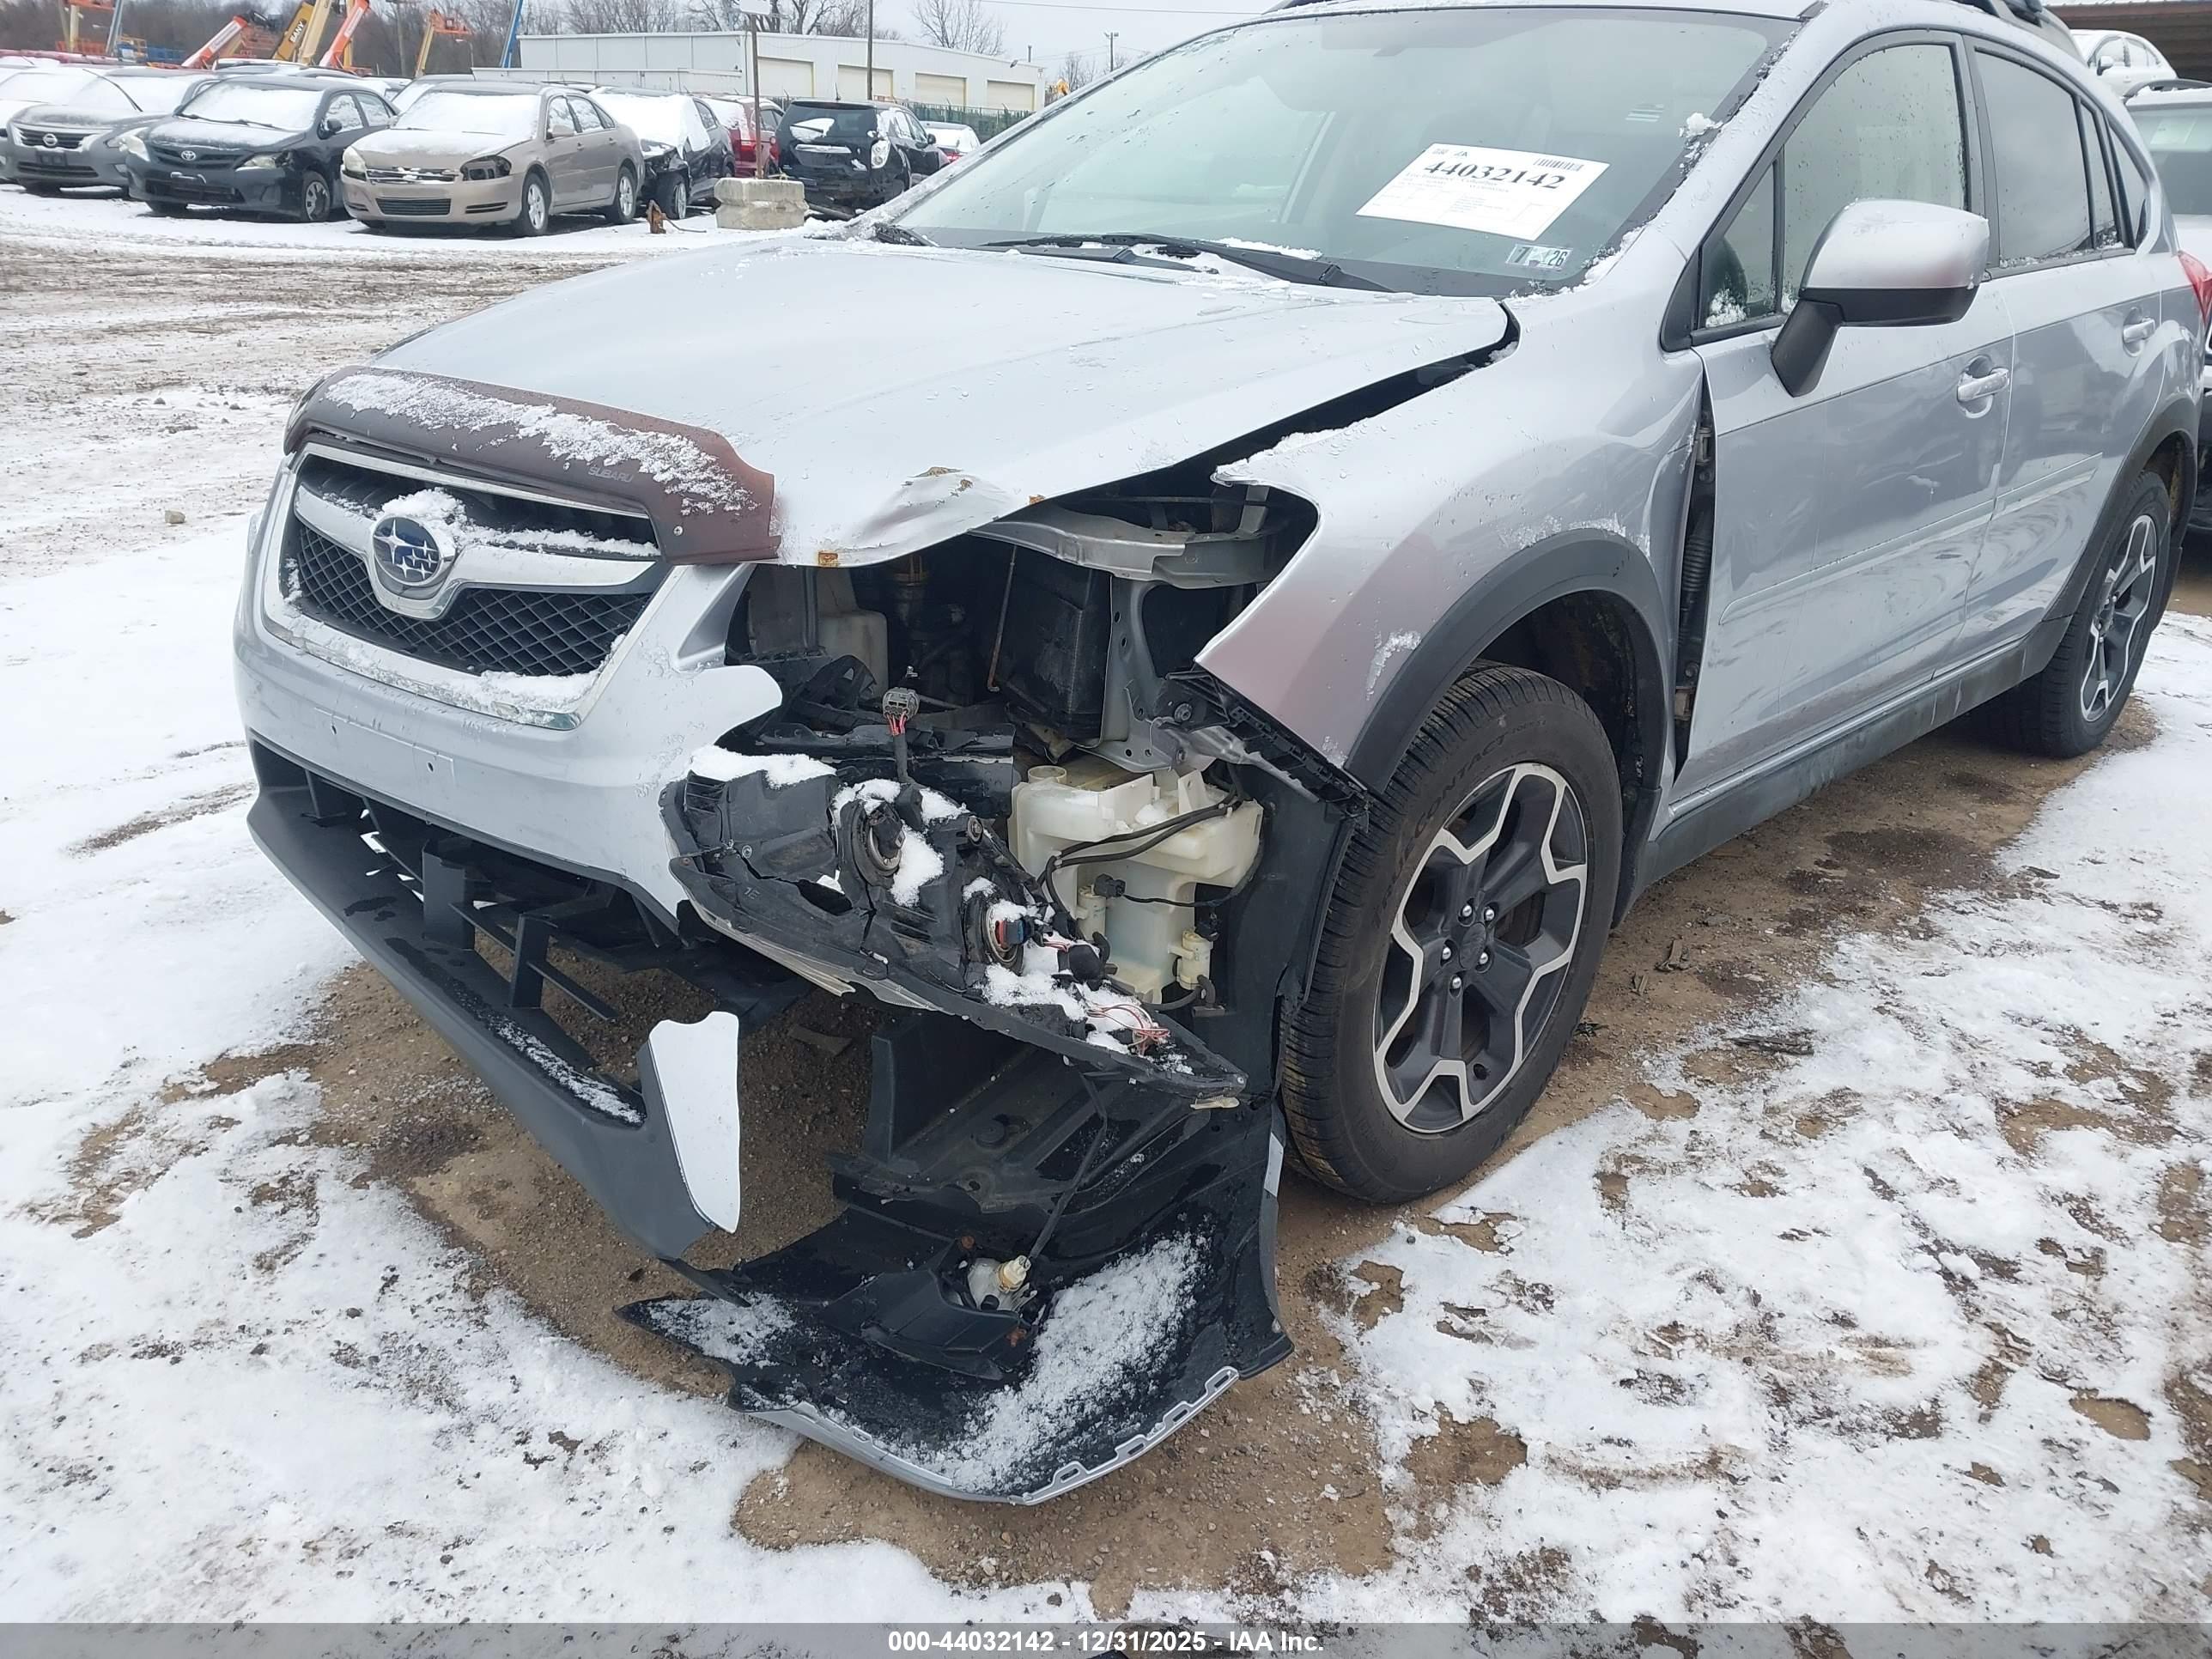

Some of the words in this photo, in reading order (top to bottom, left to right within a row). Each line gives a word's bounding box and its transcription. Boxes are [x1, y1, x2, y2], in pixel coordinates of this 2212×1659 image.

[1424, 161, 1566, 190] 44032142
[1547, 250, 1568, 267] 26
[588, 466, 634, 483] SUBARU
